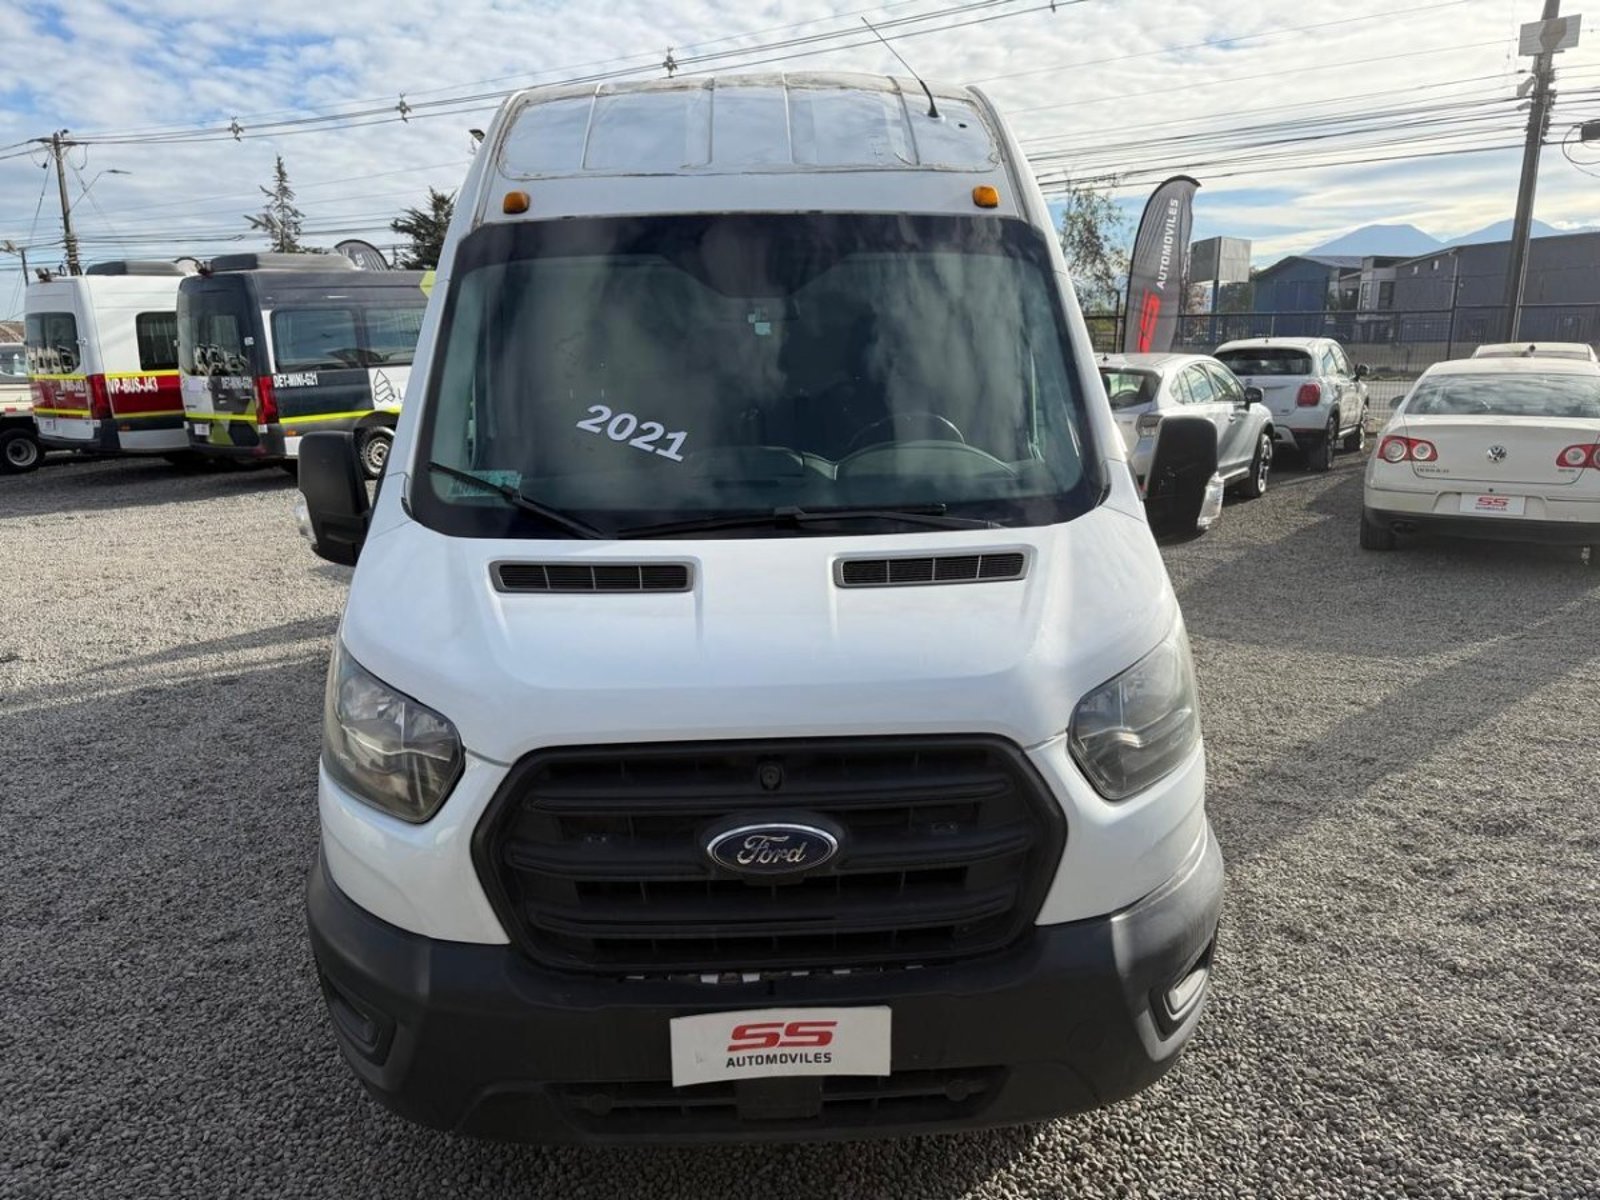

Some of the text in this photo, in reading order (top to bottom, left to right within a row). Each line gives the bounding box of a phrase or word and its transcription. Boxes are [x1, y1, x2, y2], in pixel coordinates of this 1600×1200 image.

[1156, 198, 1179, 291] AUTOMOVILES
[576, 405, 688, 462] 2021
[737, 835, 808, 865] Ford
[727, 1021, 838, 1052] SS
[726, 1052, 832, 1069] AUTOMOVILES
